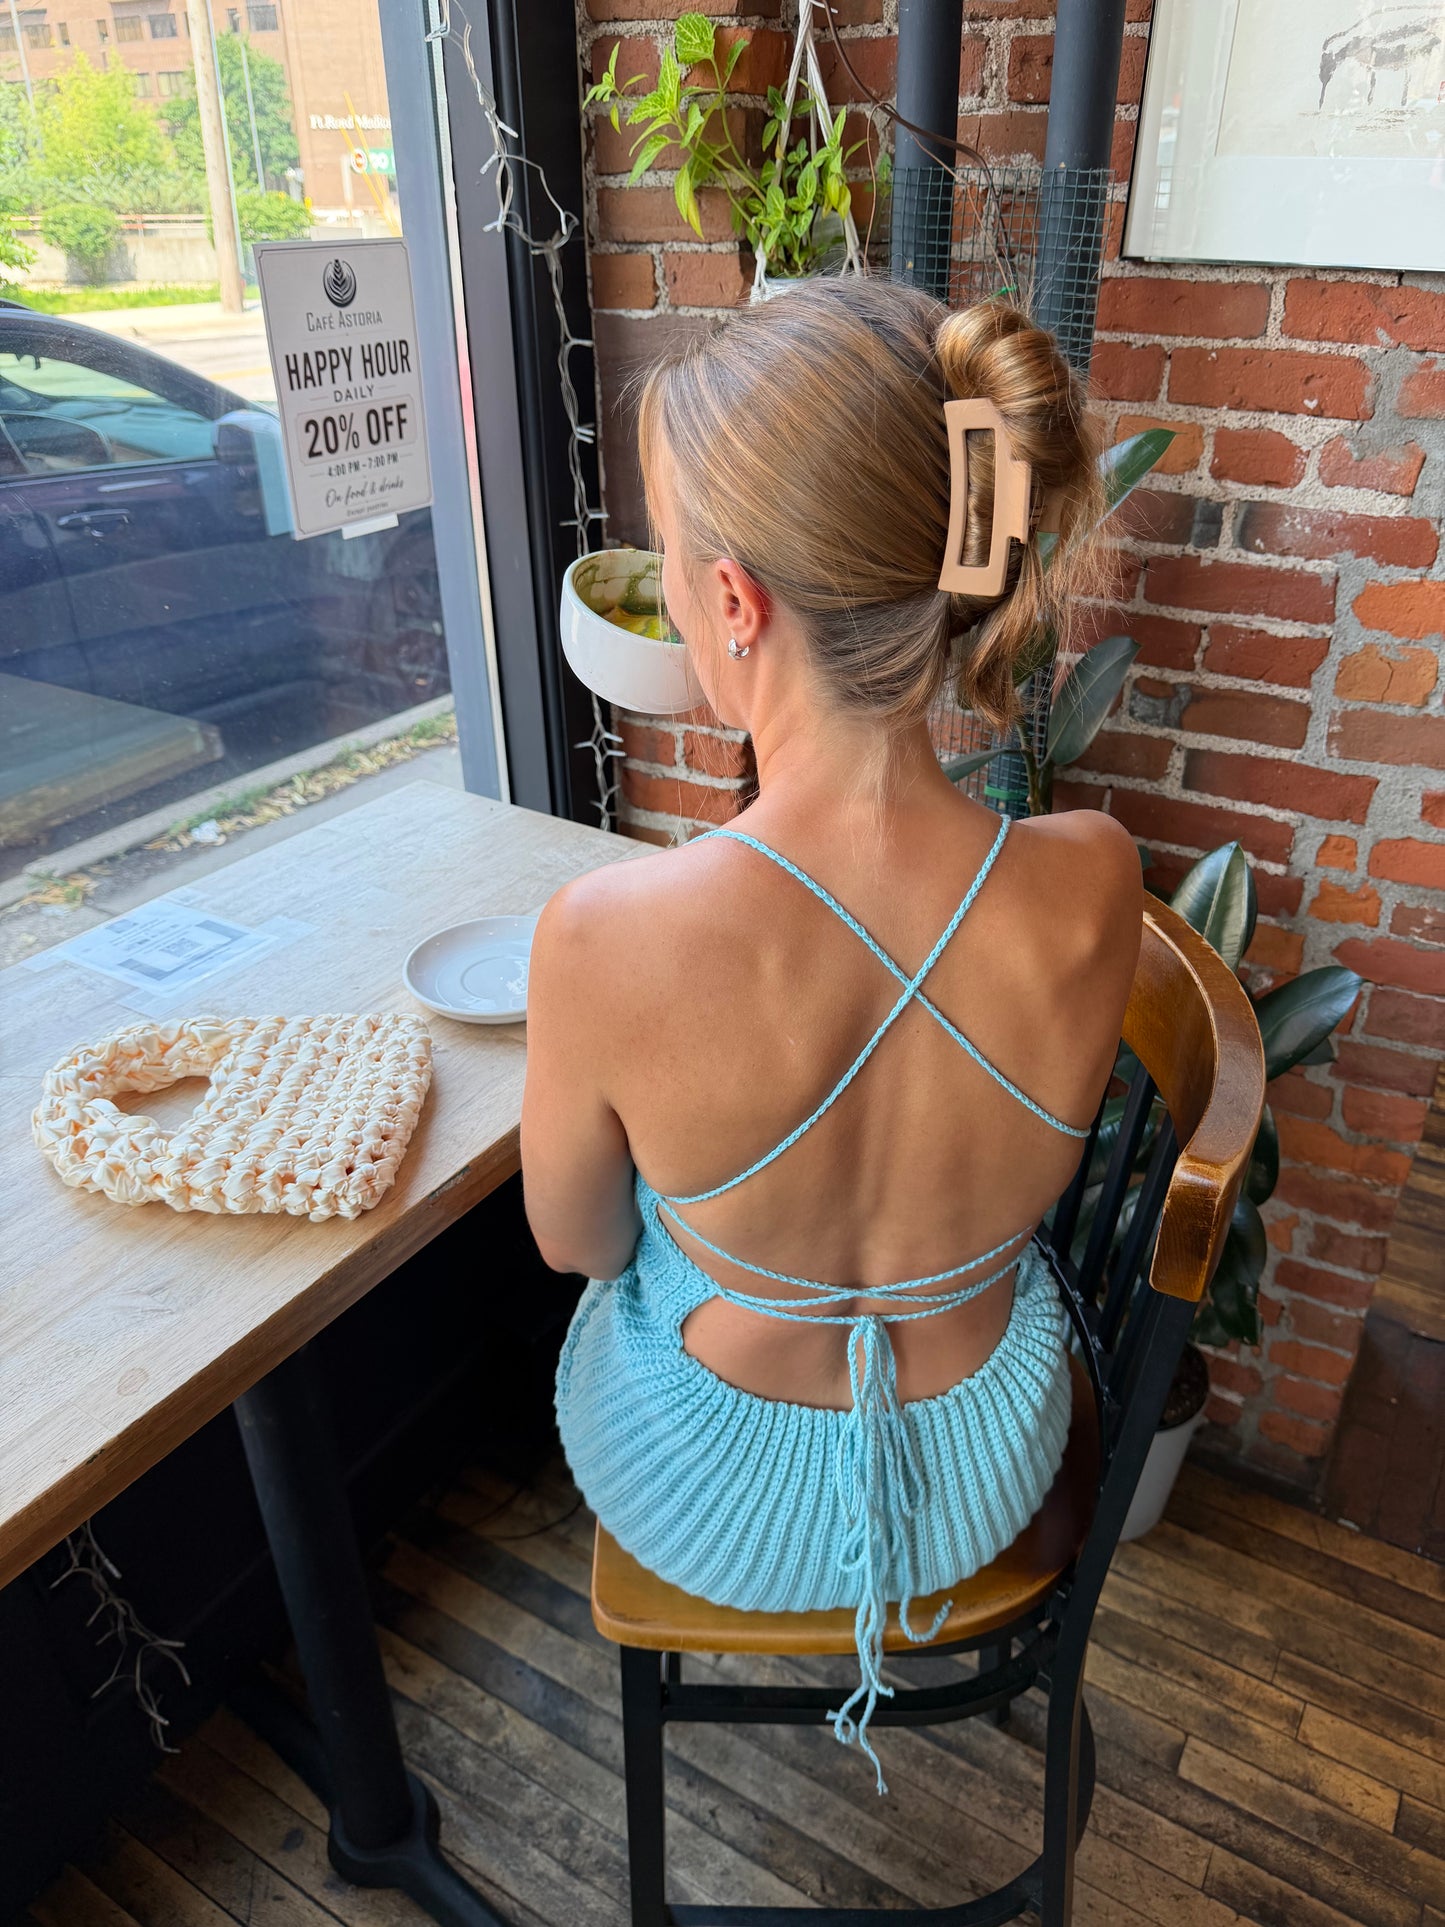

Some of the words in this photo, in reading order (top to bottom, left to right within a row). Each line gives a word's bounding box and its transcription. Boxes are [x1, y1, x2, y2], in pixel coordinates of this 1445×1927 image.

[285, 346, 352, 391] HAPPY
[360, 339, 411, 379] HOUR
[333, 384, 375, 403] DAILY
[305, 412, 360, 458] 20%
[366, 403, 407, 446] OFF
[327, 464, 347, 477] 4:00
[348, 460, 360, 473] PM
[368, 455, 386, 469] 7:00
[387, 452, 399, 465] PM
[325, 488, 341, 507] On
[344, 481, 368, 505] food
[379, 475, 403, 492] drinks
